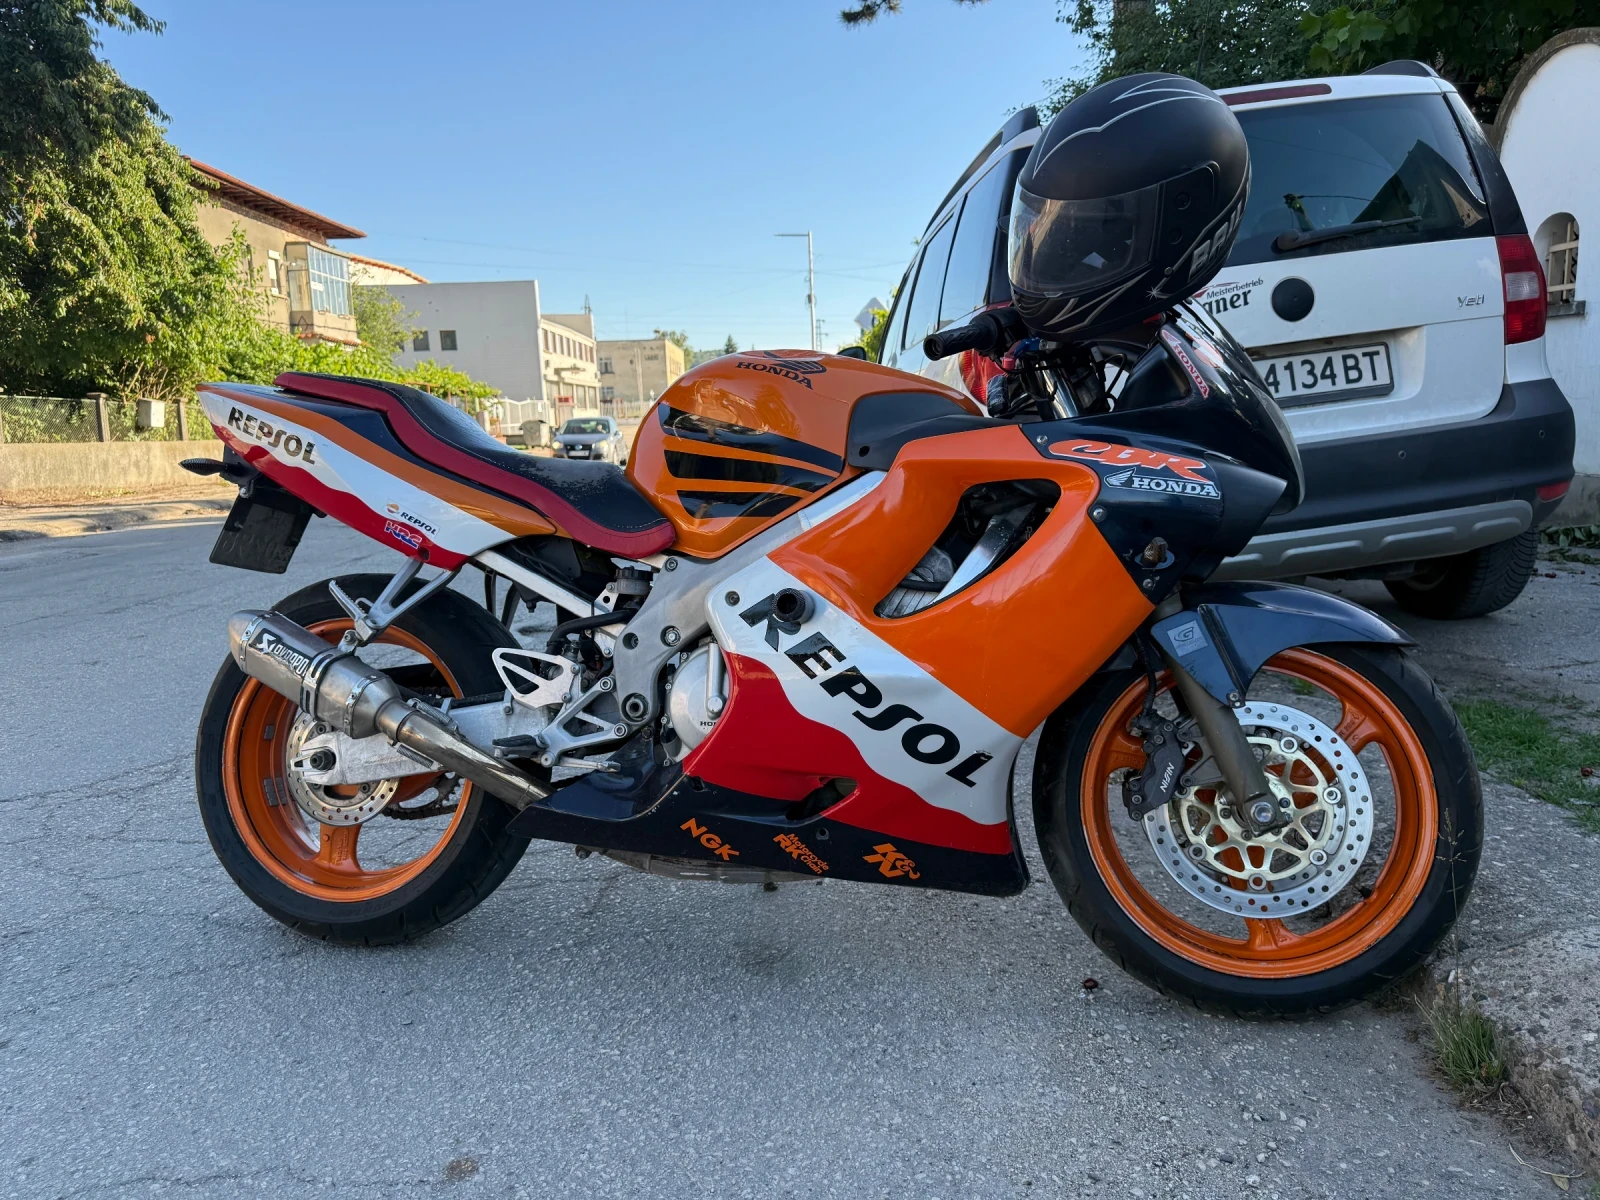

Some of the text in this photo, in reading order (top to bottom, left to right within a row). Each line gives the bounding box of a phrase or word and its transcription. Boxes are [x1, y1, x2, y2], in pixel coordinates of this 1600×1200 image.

[1206, 276, 1264, 300] Meisterbetrieb
[735, 361, 814, 390] HONDA
[1173, 343, 1210, 400] HONDA
[227, 406, 316, 465] REPSOL
[1048, 438, 1213, 484] CBR
[1131, 476, 1220, 498] HONDA
[384, 520, 423, 549] HRC
[400, 511, 437, 535] REPSOL
[738, 592, 994, 788] REPSOL
[679, 817, 740, 861] NGK
[773, 833, 805, 860] RK
[787, 833, 829, 871] Motorcycle
[800, 855, 823, 874] Chain
